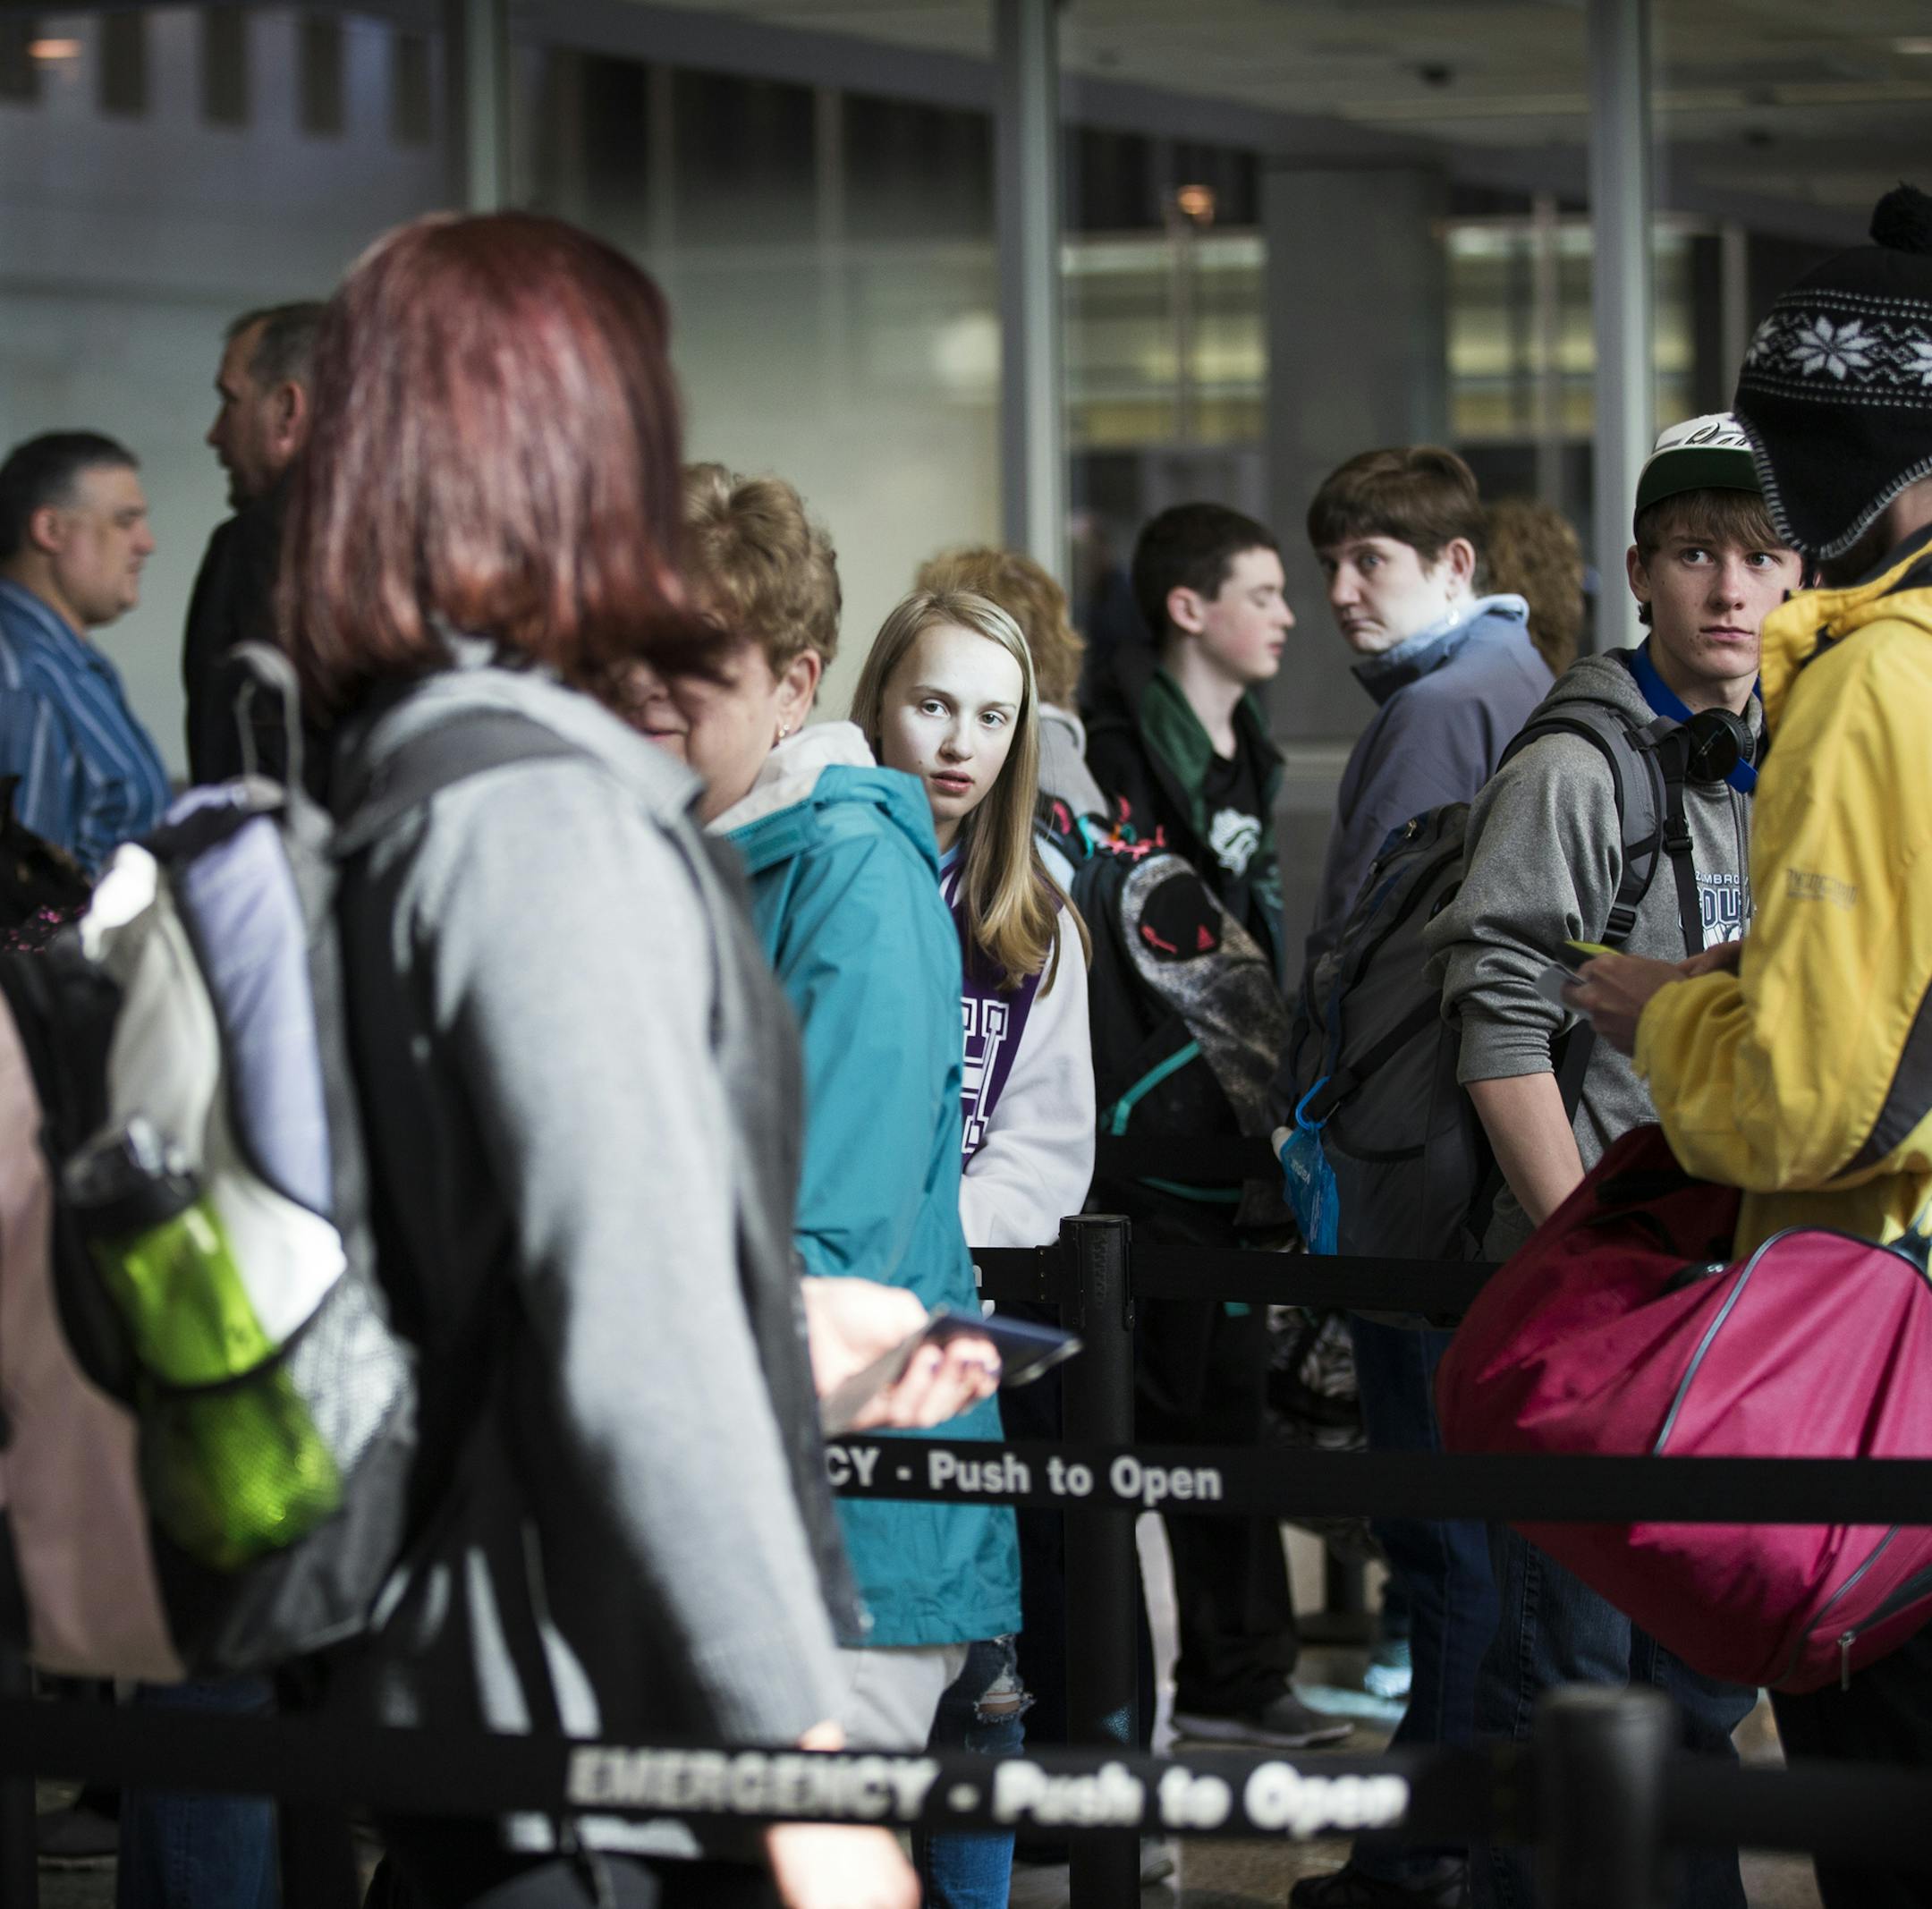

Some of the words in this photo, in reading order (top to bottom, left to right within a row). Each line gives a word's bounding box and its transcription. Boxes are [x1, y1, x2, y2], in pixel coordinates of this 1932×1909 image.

[928, 1449, 1031, 1493] Push
[1046, 1455, 1093, 1497] to
[1110, 1455, 1223, 1507] Open
[570, 1748, 939, 1820] EMERGENCY
[993, 1759, 1145, 1825] Push
[1158, 1764, 1232, 1828] to
[1244, 1760, 1410, 1838] Open
